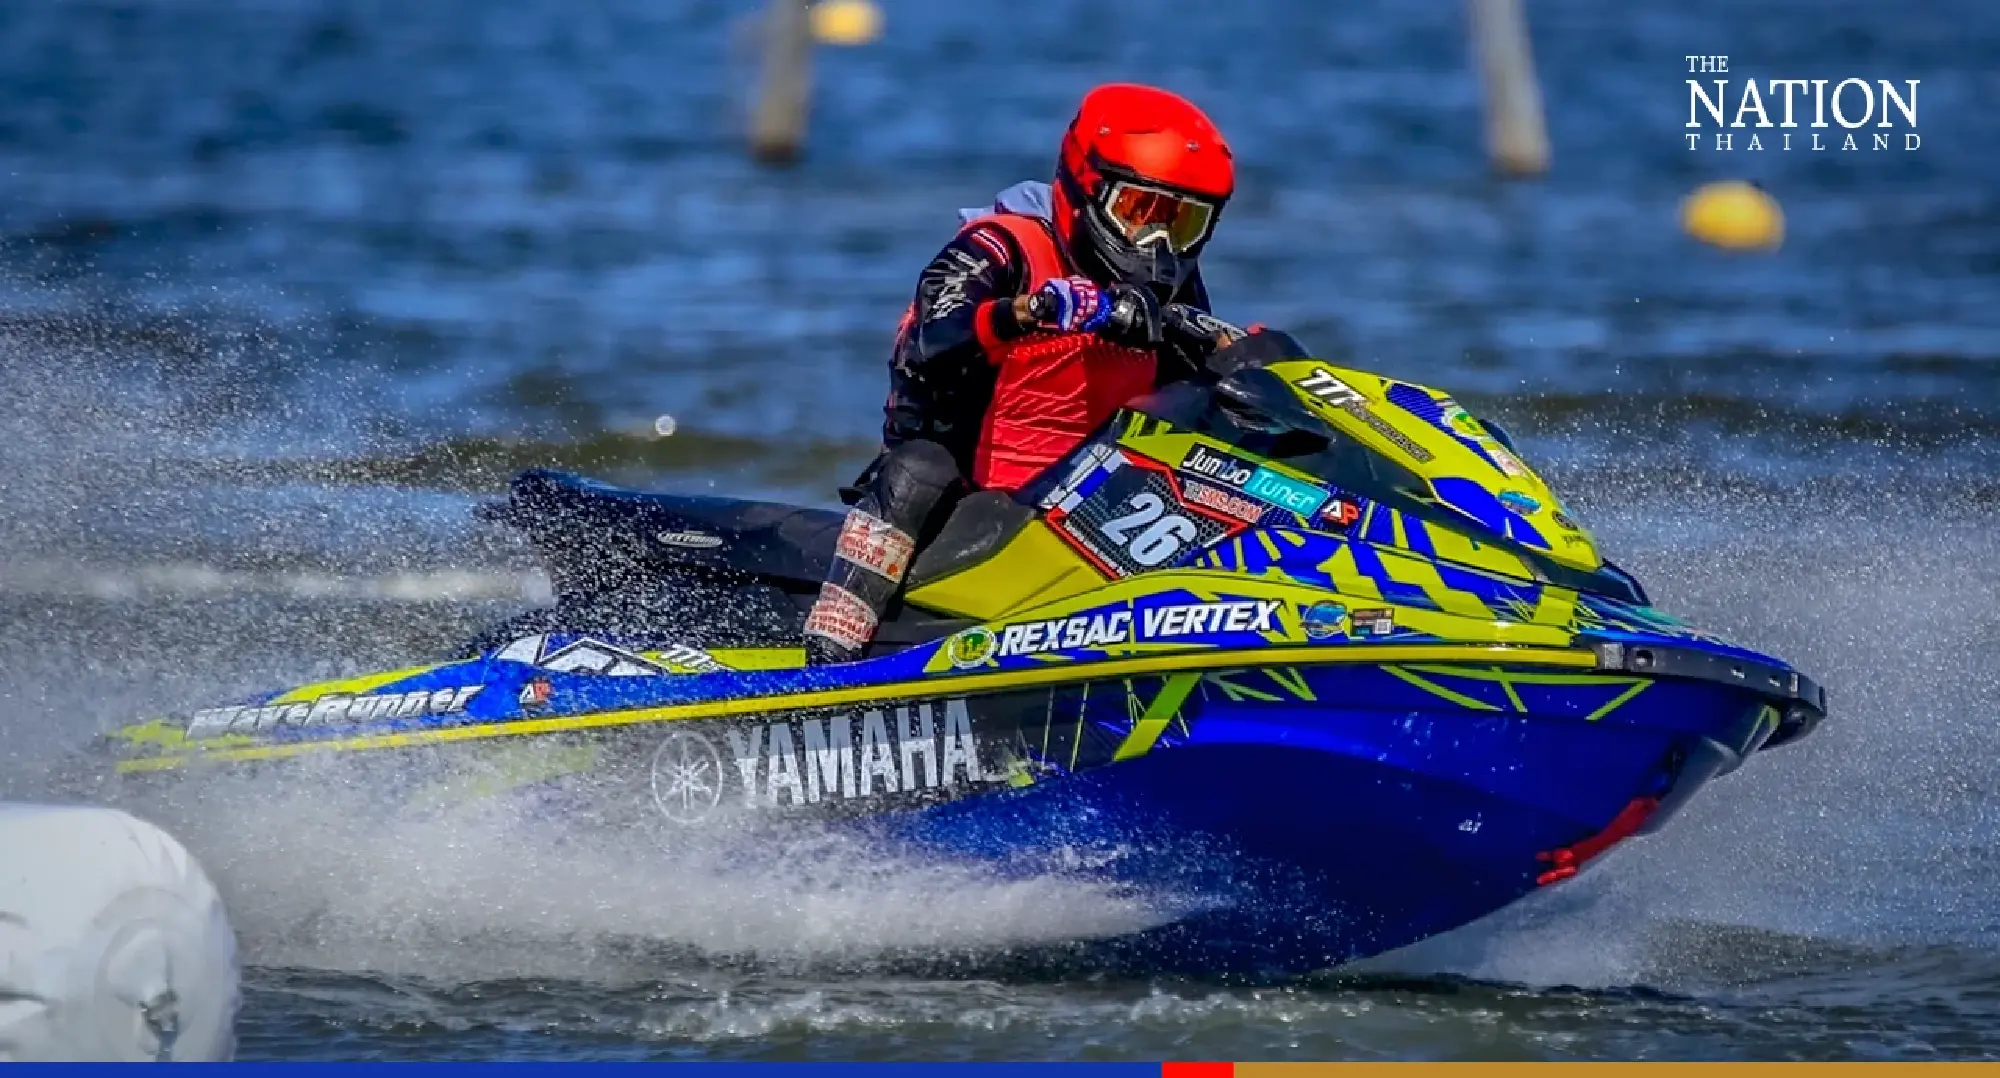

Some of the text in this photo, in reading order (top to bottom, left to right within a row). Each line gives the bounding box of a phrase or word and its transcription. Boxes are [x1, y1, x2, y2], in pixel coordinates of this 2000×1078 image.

[1100, 491, 1197, 567] 26
[998, 611, 1134, 657] REXSAC
[1142, 600, 1280, 638] VERTEX
[727, 699, 981, 809] YAMAHA
